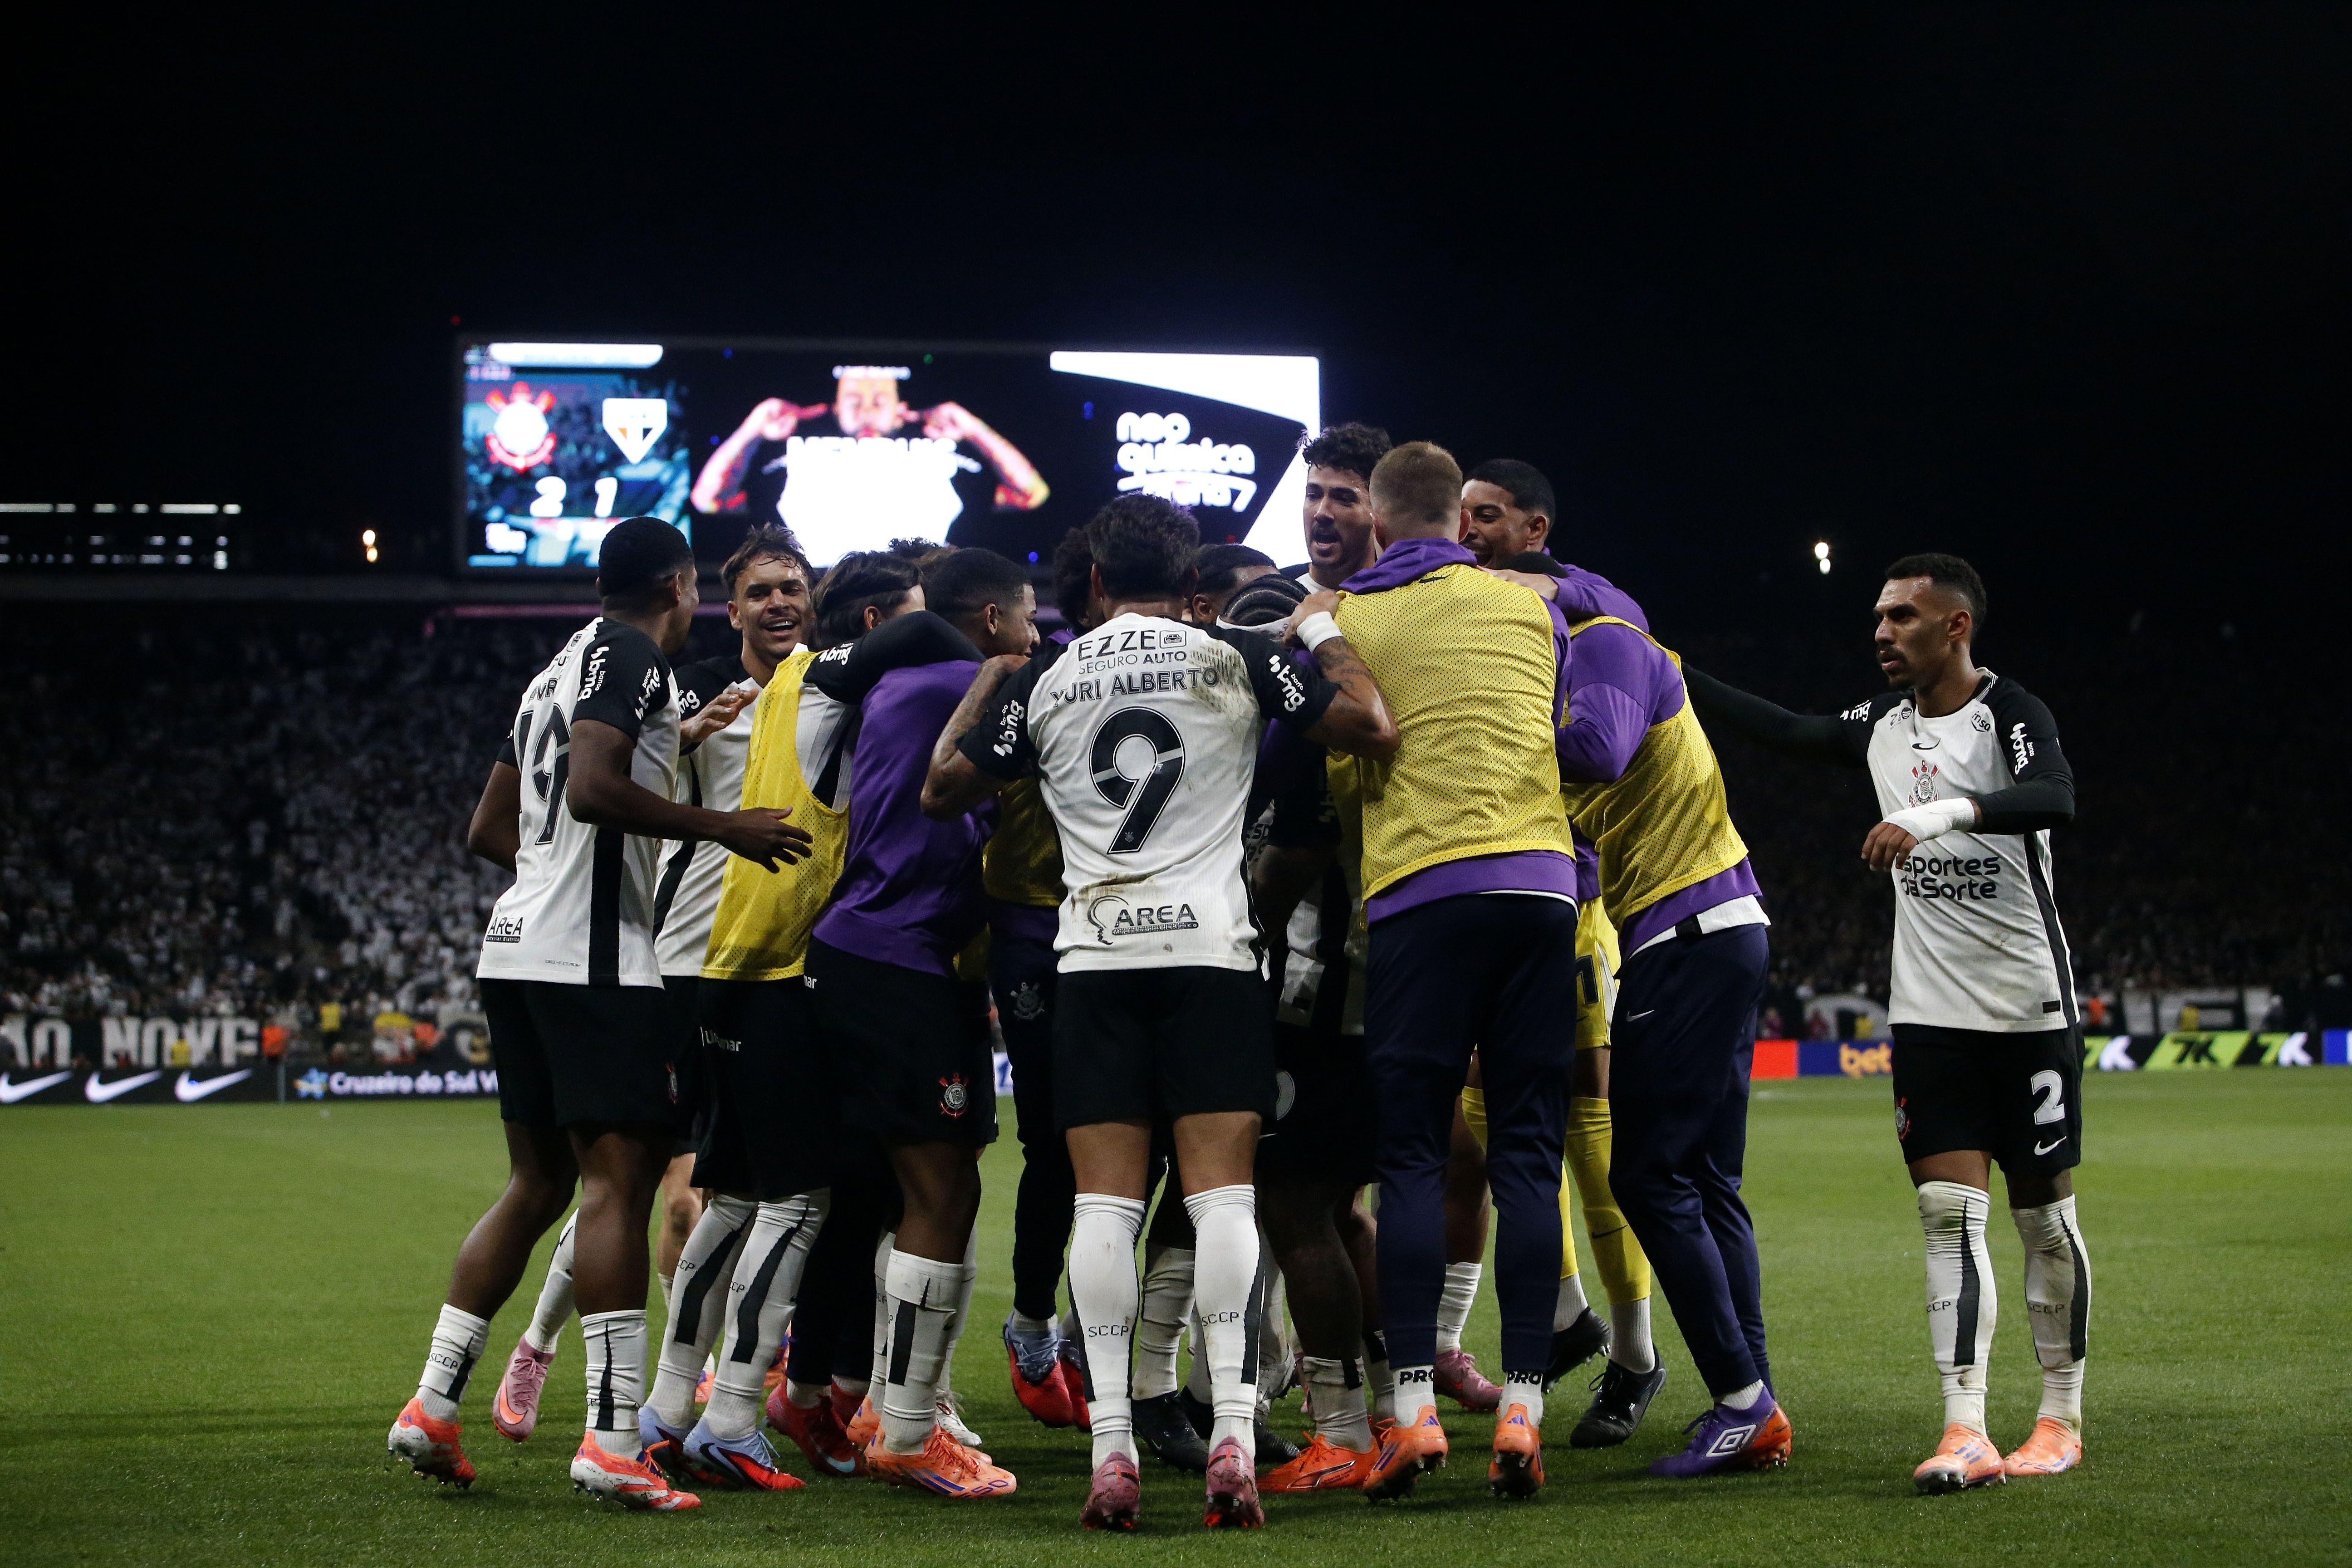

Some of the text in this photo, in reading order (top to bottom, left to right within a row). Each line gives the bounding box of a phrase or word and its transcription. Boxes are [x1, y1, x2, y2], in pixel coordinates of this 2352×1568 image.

[530, 476, 618, 517] 2 1
[1078, 630, 1156, 662] EZZE
[1078, 651, 1187, 674] SEGURO AUTO
[594, 671, 606, 691] banco
[1050, 666, 1220, 708] YURI ALBERTO
[1090, 706, 1186, 854] 9
[1903, 854, 2000, 879] sportes
[488, 916, 523, 935] AREA
[1114, 903, 1196, 928] AREA
[329, 1071, 414, 1095] Cruzeiro
[415, 1069, 443, 1094] do
[444, 1069, 477, 1094] Sul
[2031, 1069, 2065, 1125] 2
[1088, 1325, 1129, 1338] SCCP
[1201, 1312, 1239, 1326] SCCP
[429, 1353, 458, 1369] SCCP
